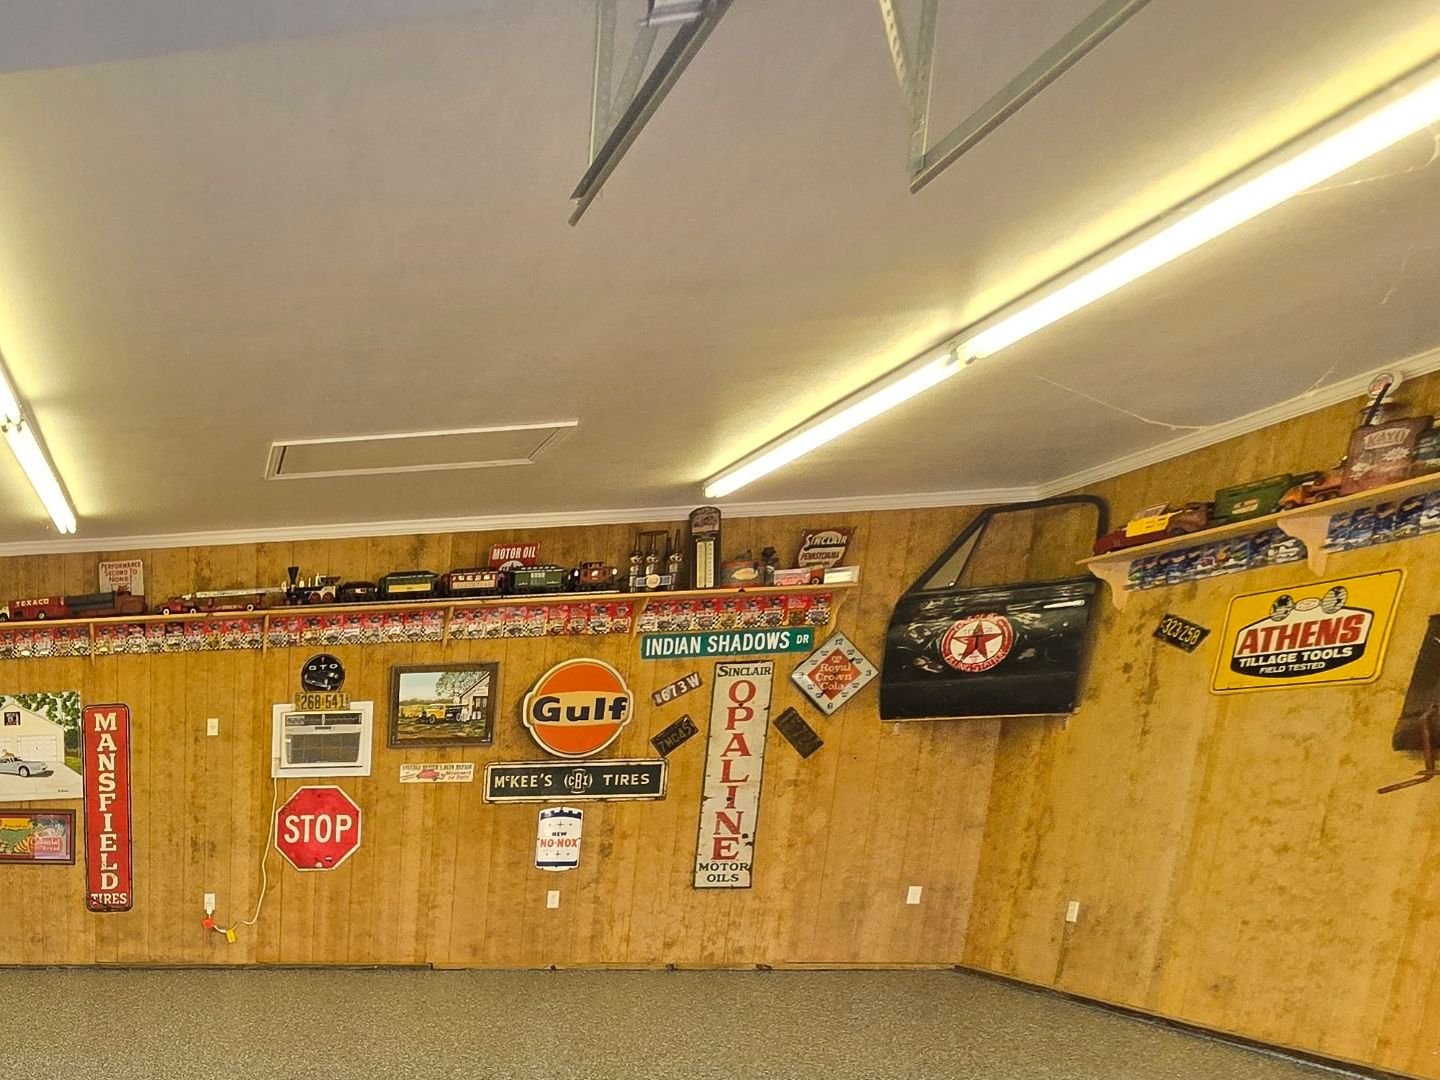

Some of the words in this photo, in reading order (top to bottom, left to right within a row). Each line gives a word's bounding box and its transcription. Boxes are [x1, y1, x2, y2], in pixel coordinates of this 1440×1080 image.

[804, 534, 848, 550] SINCLAIR
[492, 547, 521, 560] MOTOR
[523, 546, 536, 559] OIL
[101, 561, 141, 570] PERFORMANCE
[15, 598, 50, 608] TEXACO
[1237, 614, 1365, 656] ATHENS
[645, 636, 702, 656] INDIAN
[707, 632, 790, 653] SHADOWS
[796, 634, 809, 645] DR
[1239, 650, 1299, 668] TILLAGE
[1302, 646, 1353, 662] TOOLS
[717, 665, 772, 677] SINCLAIR
[820, 663, 851, 672] Royal
[1259, 664, 1286, 674] FIELD
[1288, 662, 1326, 672] TESTED
[815, 673, 852, 681] Crown
[820, 682, 844, 690] Cola
[532, 696, 627, 722] Gulf
[711, 680, 757, 861] OPALINE
[603, 773, 650, 786] TIRES
[94, 712, 120, 890] MANSFIELD
[284, 814, 352, 843] STOP
[539, 838, 578, 848] NO-NOX
[698, 862, 749, 872] MOTOR
[706, 874, 739, 882] OILS
[91, 893, 128, 905] TIRES
